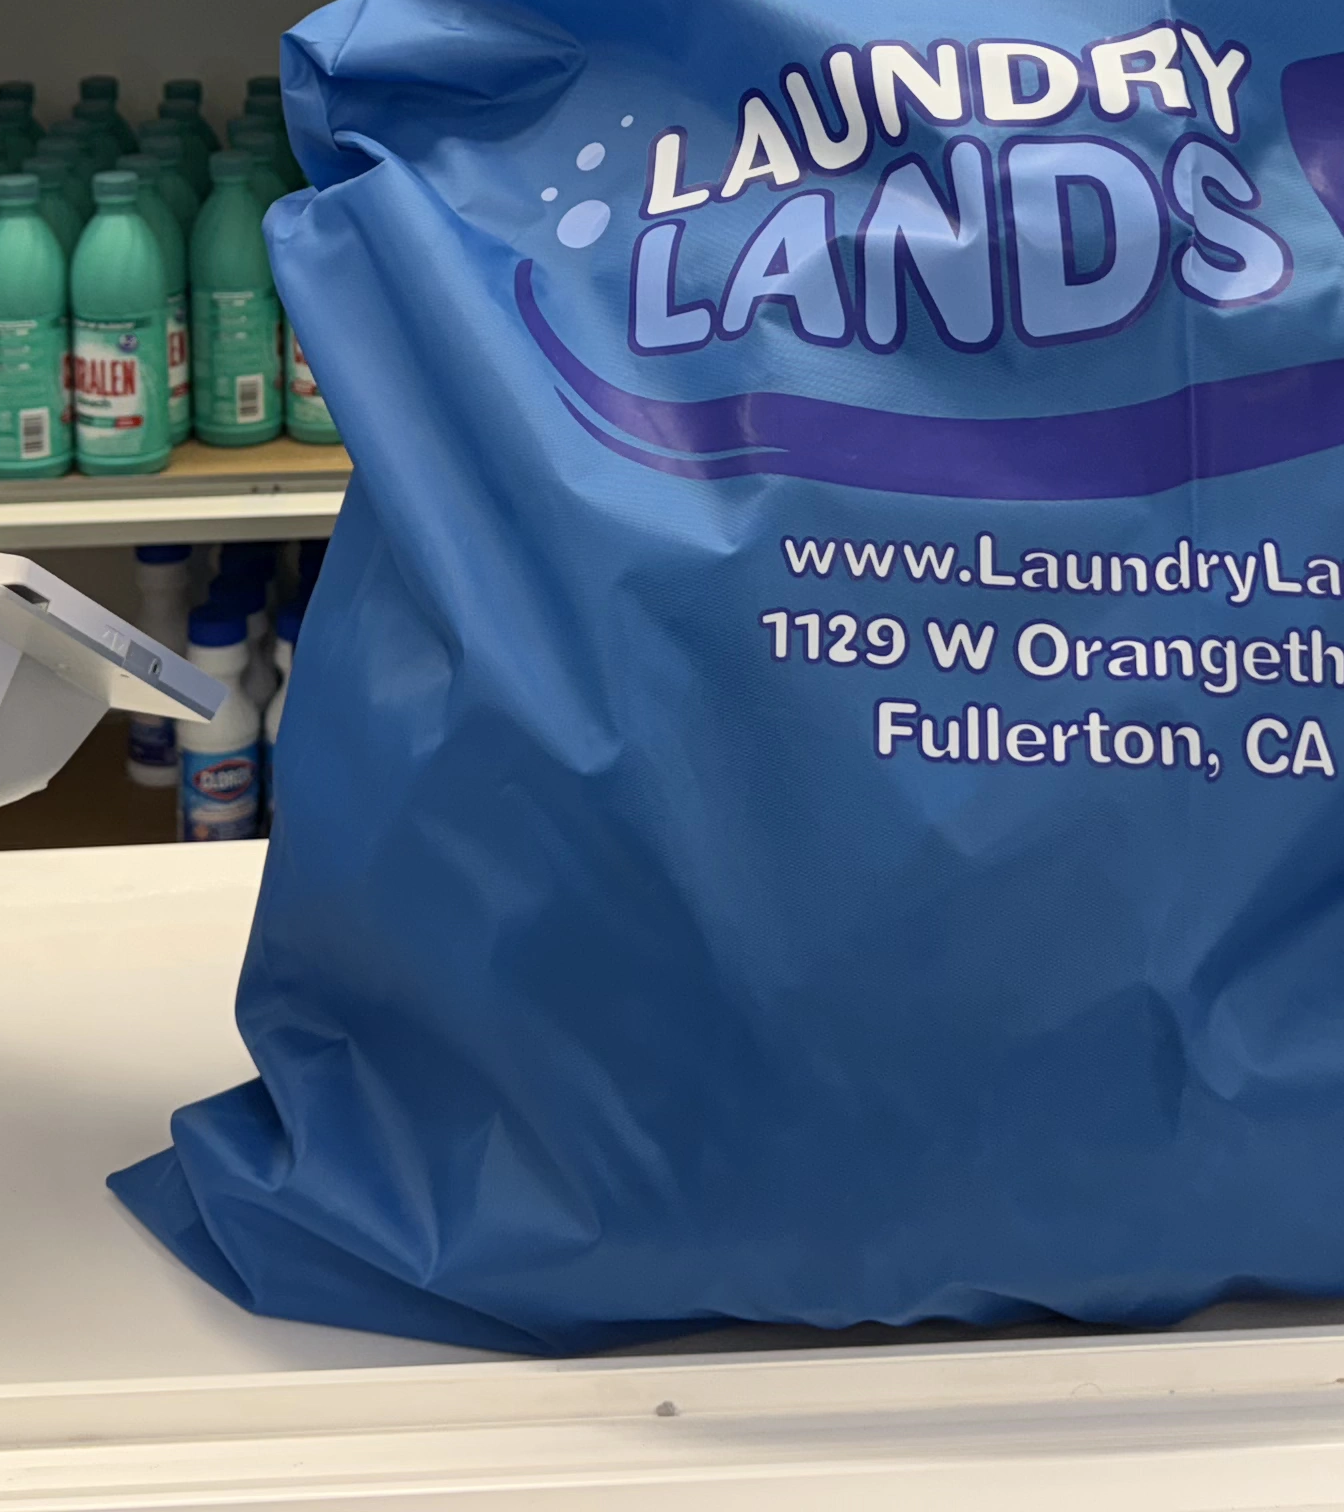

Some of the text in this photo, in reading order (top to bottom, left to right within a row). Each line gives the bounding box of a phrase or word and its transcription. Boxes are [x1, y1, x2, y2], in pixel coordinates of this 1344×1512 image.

[643, 21, 1248, 217] LAUNDRY
[629, 134, 1292, 354] LANDS
[762, 610, 906, 667] 1129
[928, 620, 995, 671] W
[876, 701, 1221, 779] Fullerton,
[1245, 717, 1336, 778] CA
